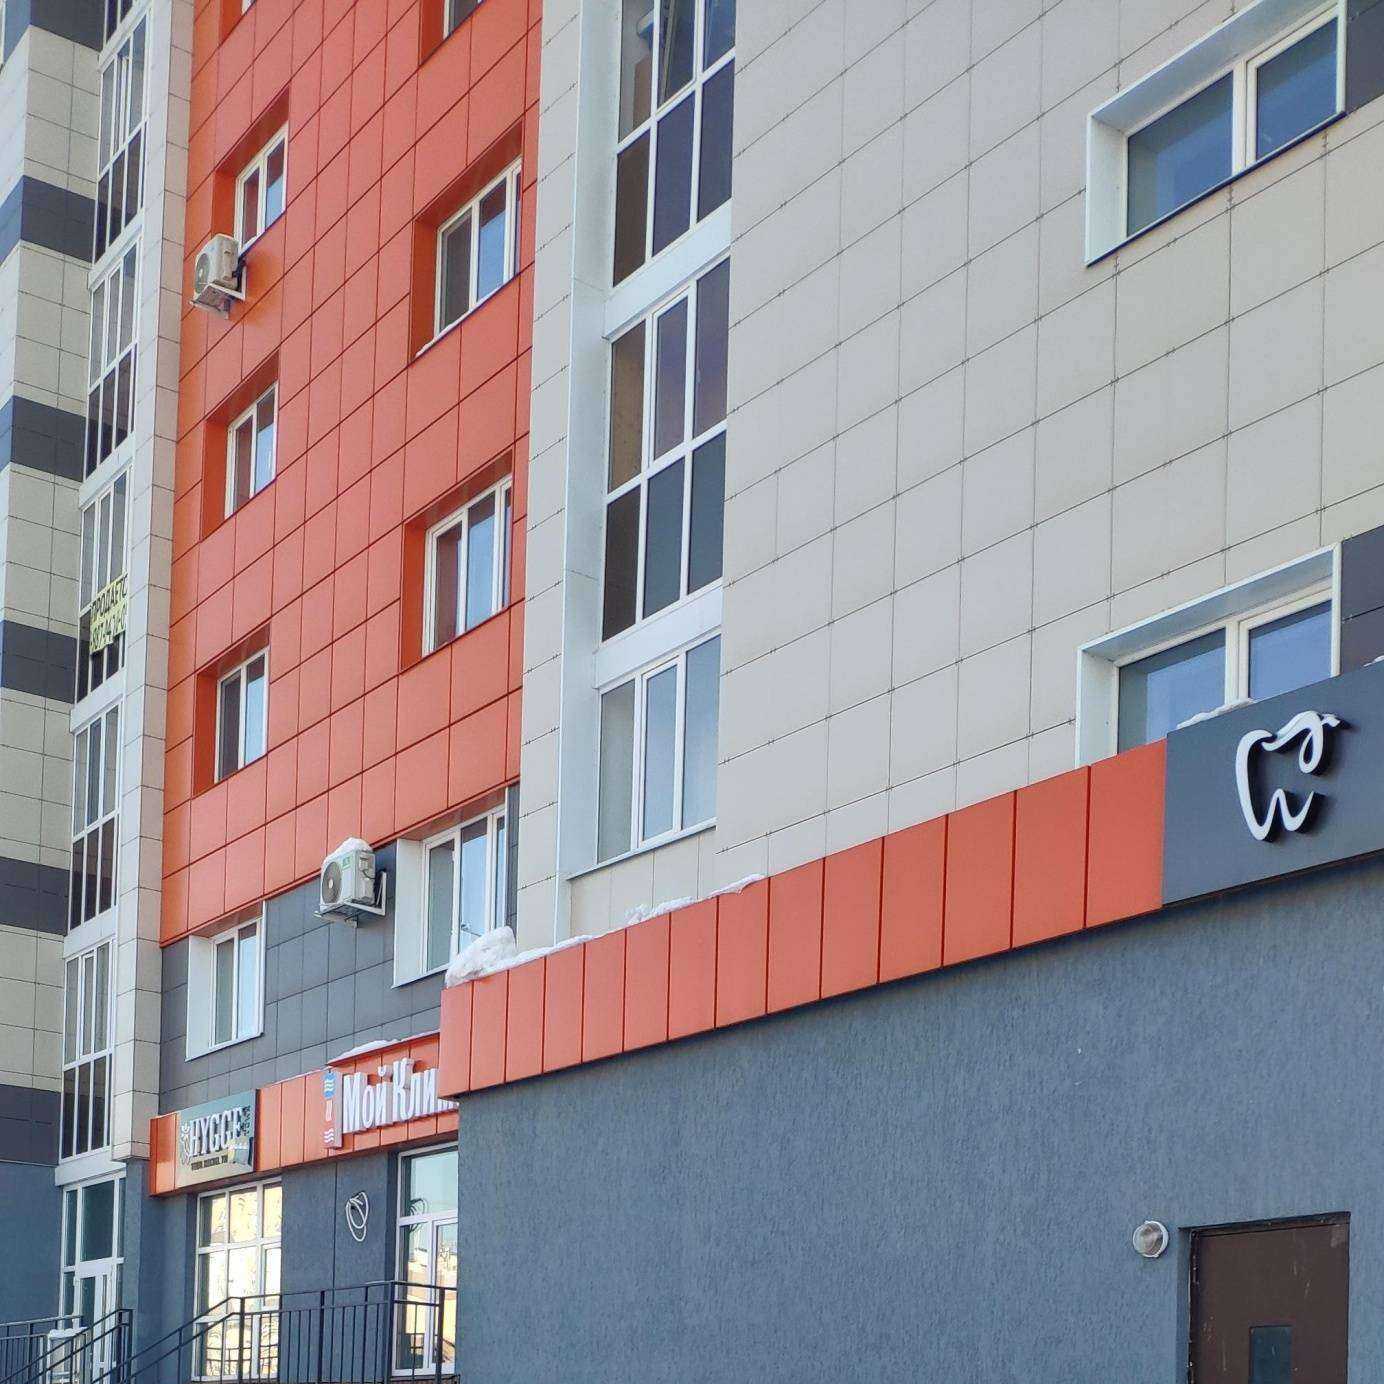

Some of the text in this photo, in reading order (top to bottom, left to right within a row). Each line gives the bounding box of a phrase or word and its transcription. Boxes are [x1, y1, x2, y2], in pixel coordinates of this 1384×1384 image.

[342, 1057, 460, 1134] Мой Кли
[188, 1107, 244, 1157] HYGGE
